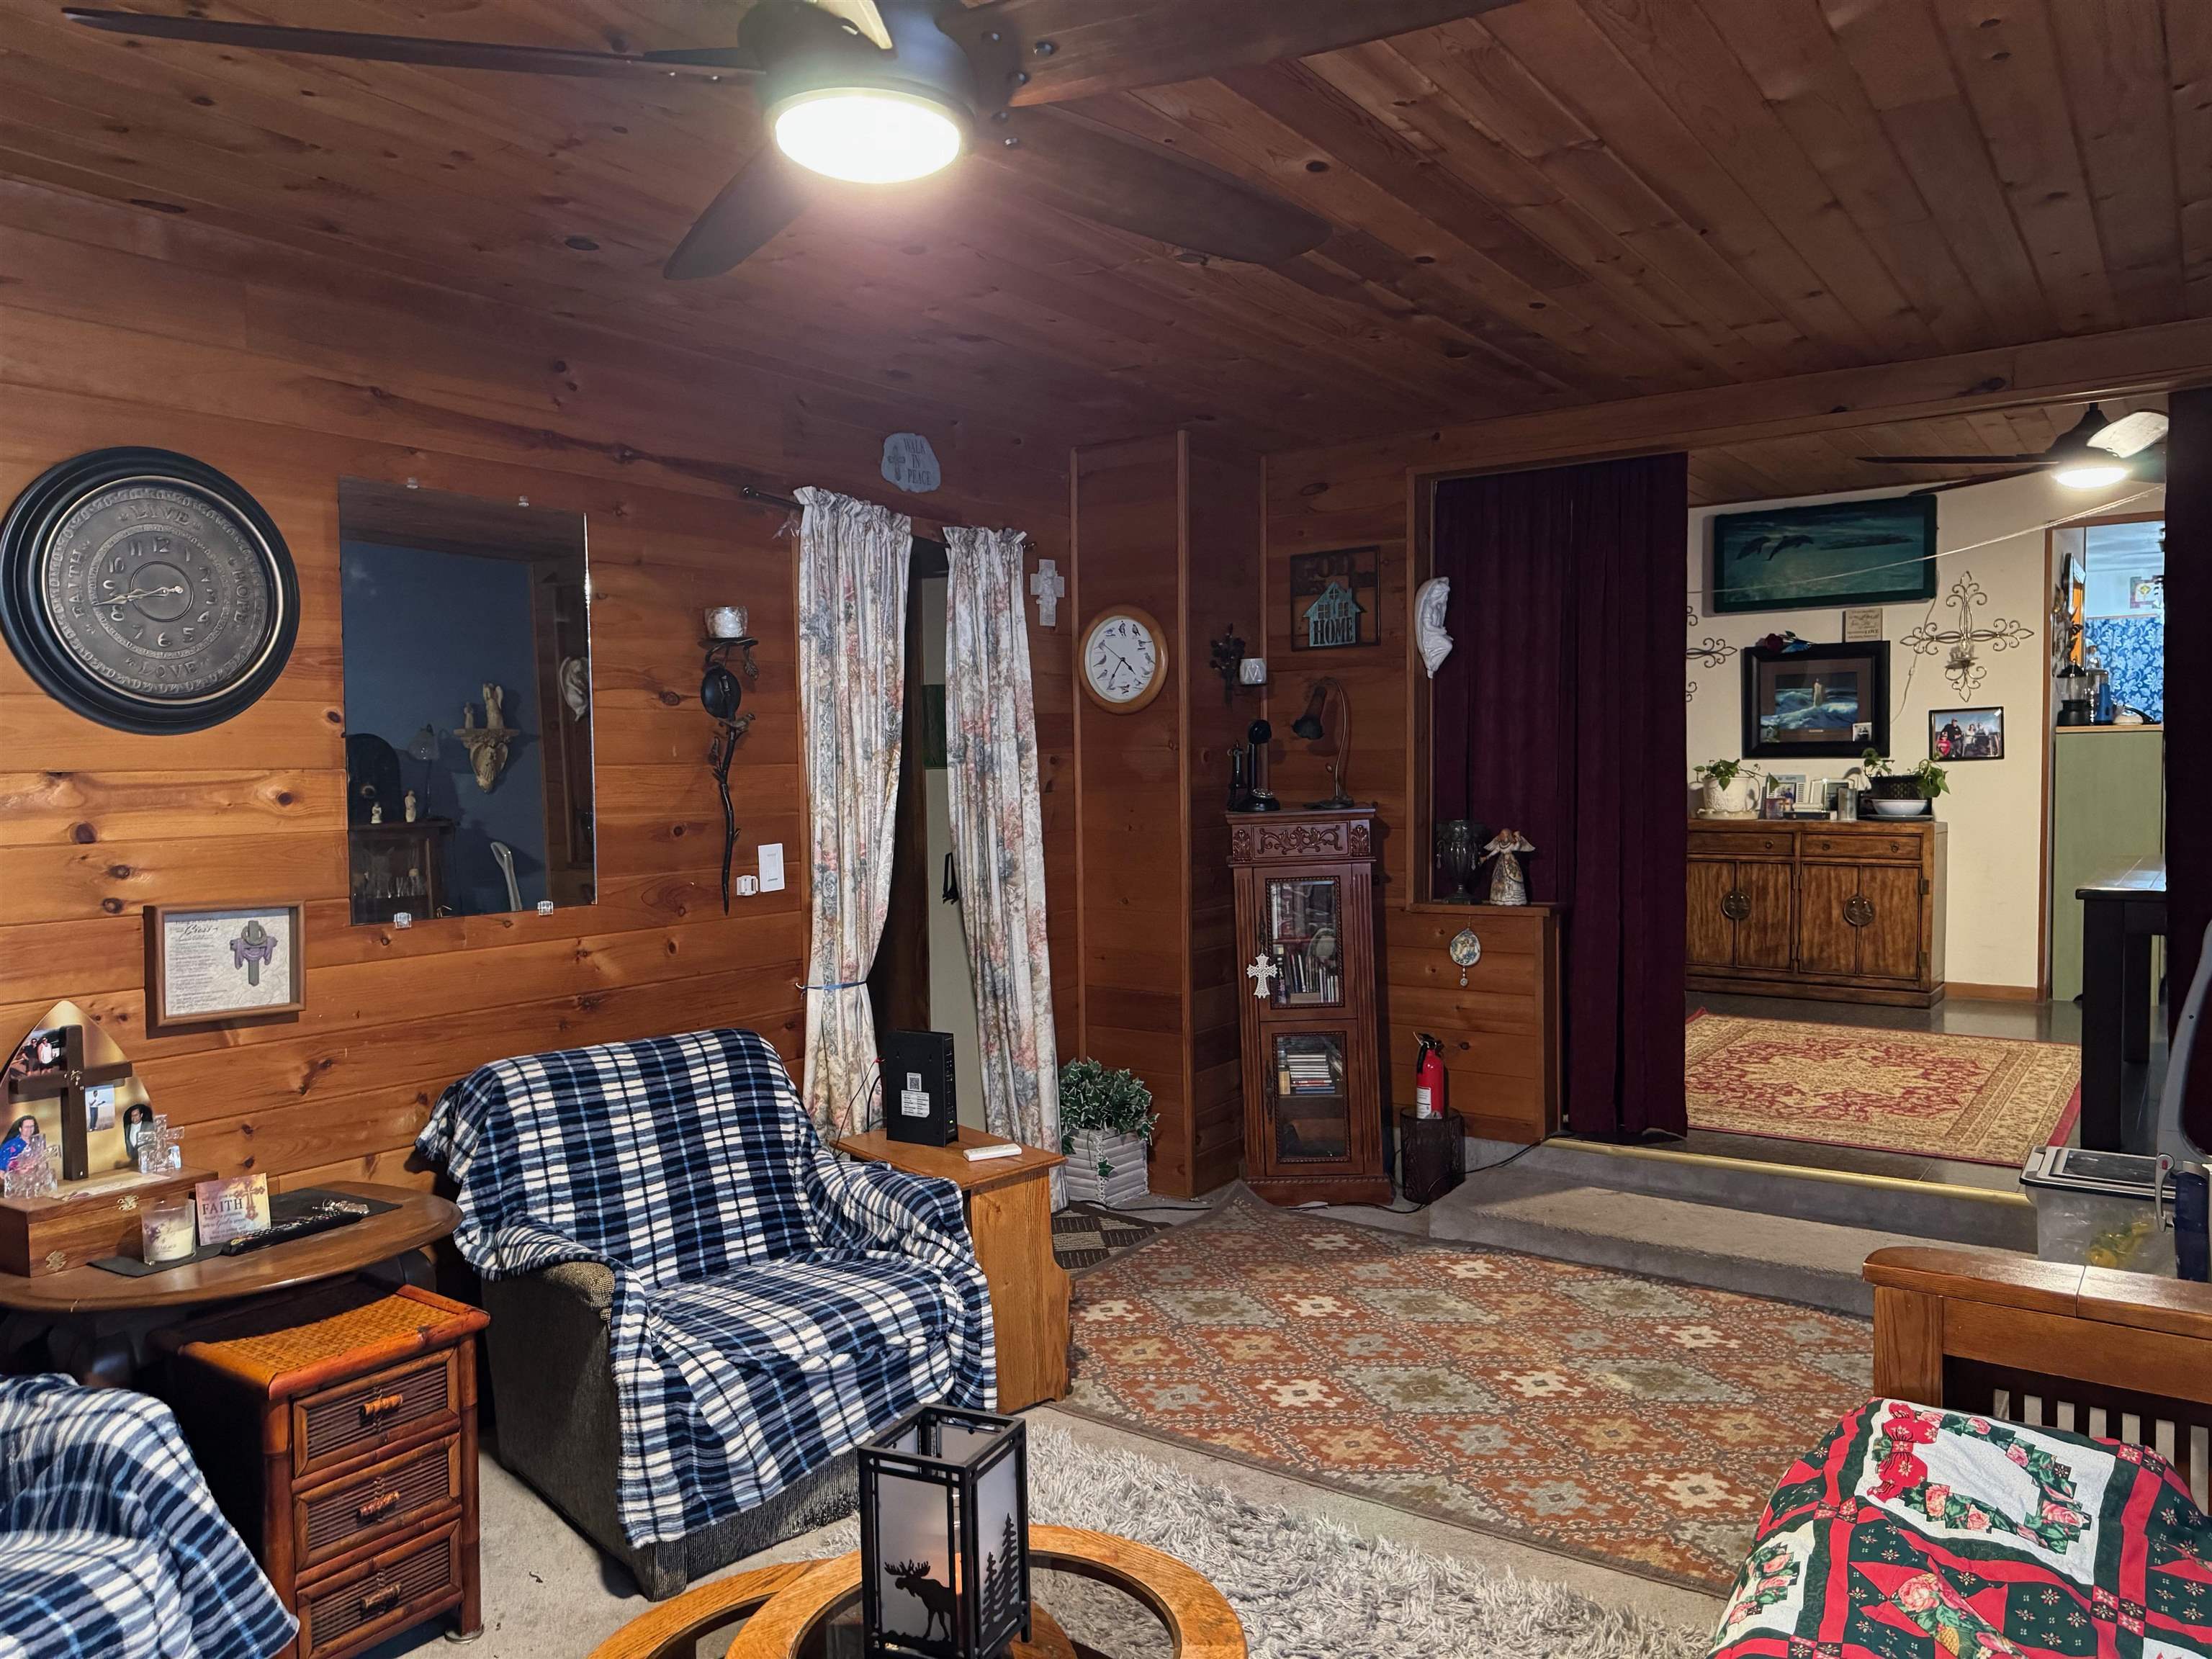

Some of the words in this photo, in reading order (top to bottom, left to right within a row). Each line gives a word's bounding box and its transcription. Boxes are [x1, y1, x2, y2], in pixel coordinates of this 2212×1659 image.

[904, 438, 925, 454] WALK
[912, 454, 920, 468] IN
[907, 469, 932, 485] PEACE
[129, 505, 190, 525] LIVE
[130, 541, 143, 557] 11
[153, 537, 170, 553] 12
[185, 547, 191, 562] 1
[109, 557, 125, 573] 10
[199, 567, 212, 583] 2
[68, 549, 85, 619] FAITH
[206, 588, 216, 606] 3
[233, 571, 249, 624] HOPE
[110, 604, 125, 622] 8
[197, 611, 210, 625] 4
[132, 624, 144, 639] 7
[182, 627, 195, 643] 5
[1313, 618, 1354, 645] HOME
[157, 632, 173, 648] 6
[138, 661, 198, 678] LOVE
[202, 1199, 243, 1215] FAITH
